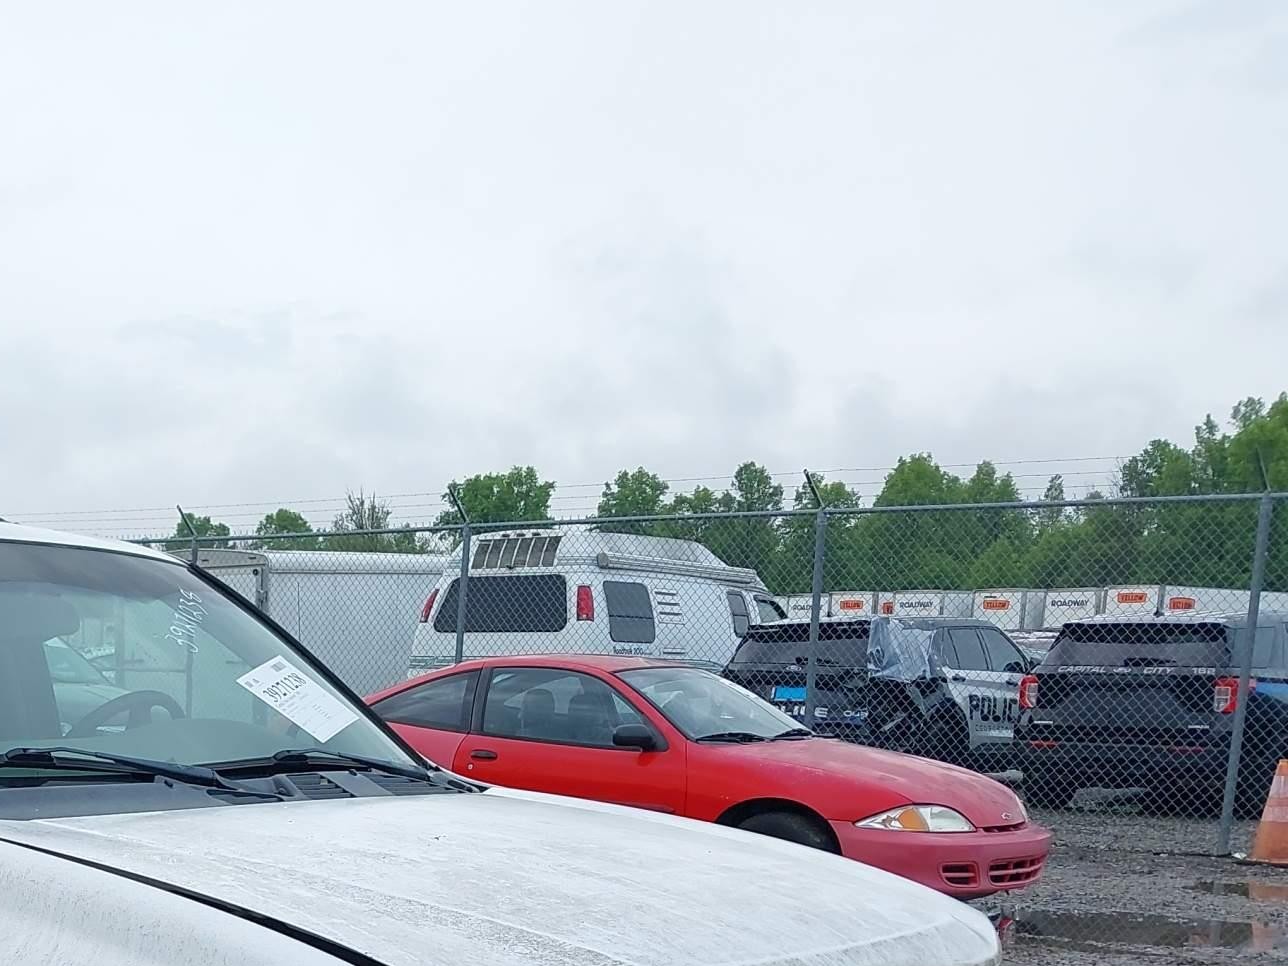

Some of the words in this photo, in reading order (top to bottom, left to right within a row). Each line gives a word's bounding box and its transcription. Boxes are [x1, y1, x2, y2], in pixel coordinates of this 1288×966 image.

[899, 601, 933, 609] ROADWAY
[1051, 599, 1090, 607] ROADWAY
[1057, 665, 1106, 674] CAPITAL
[1143, 666, 1175, 674] CITY
[969, 694, 1021, 723] POLIC
